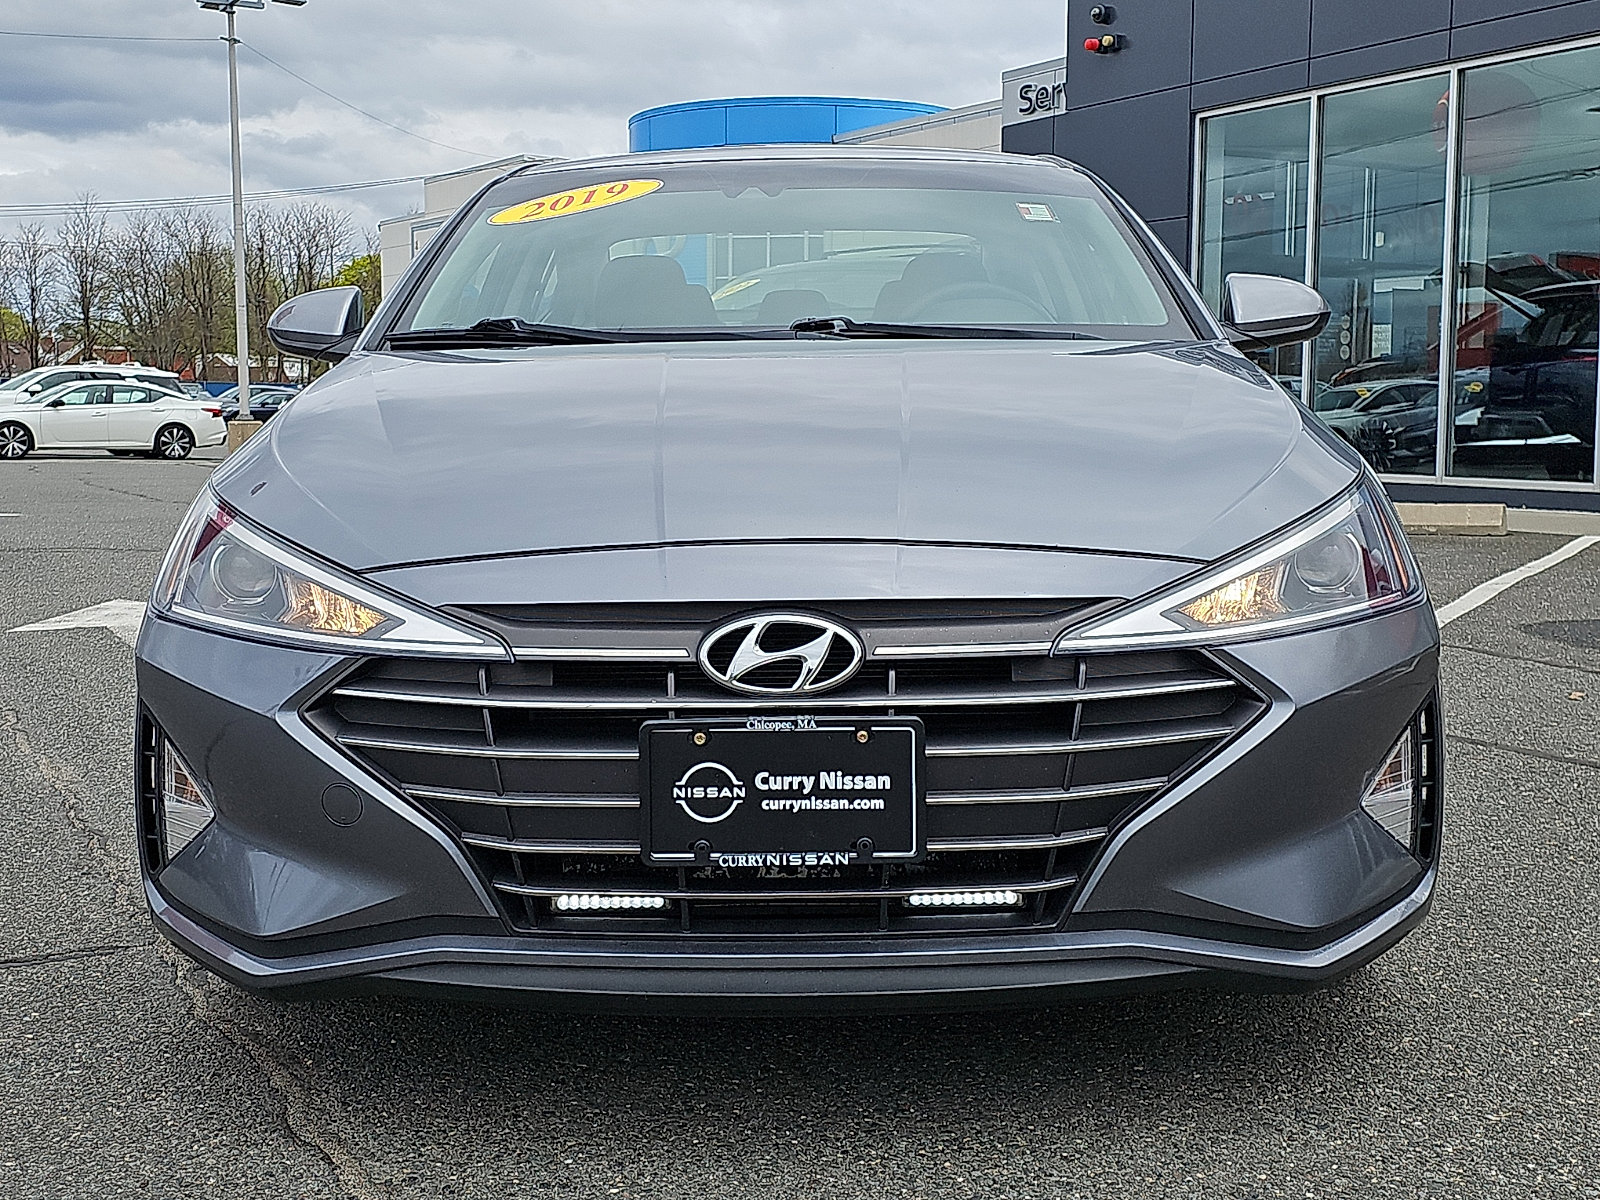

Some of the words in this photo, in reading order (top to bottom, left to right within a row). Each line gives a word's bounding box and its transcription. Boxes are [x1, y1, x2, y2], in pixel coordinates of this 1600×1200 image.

[520, 184, 629, 219] 2019
[746, 720, 795, 731] Chicopee,
[797, 719, 817, 729] MA
[755, 772, 815, 794] Curry
[819, 771, 891, 790] Nissan
[673, 787, 746, 798] NISSAN
[761, 796, 885, 812] currynissan.com
